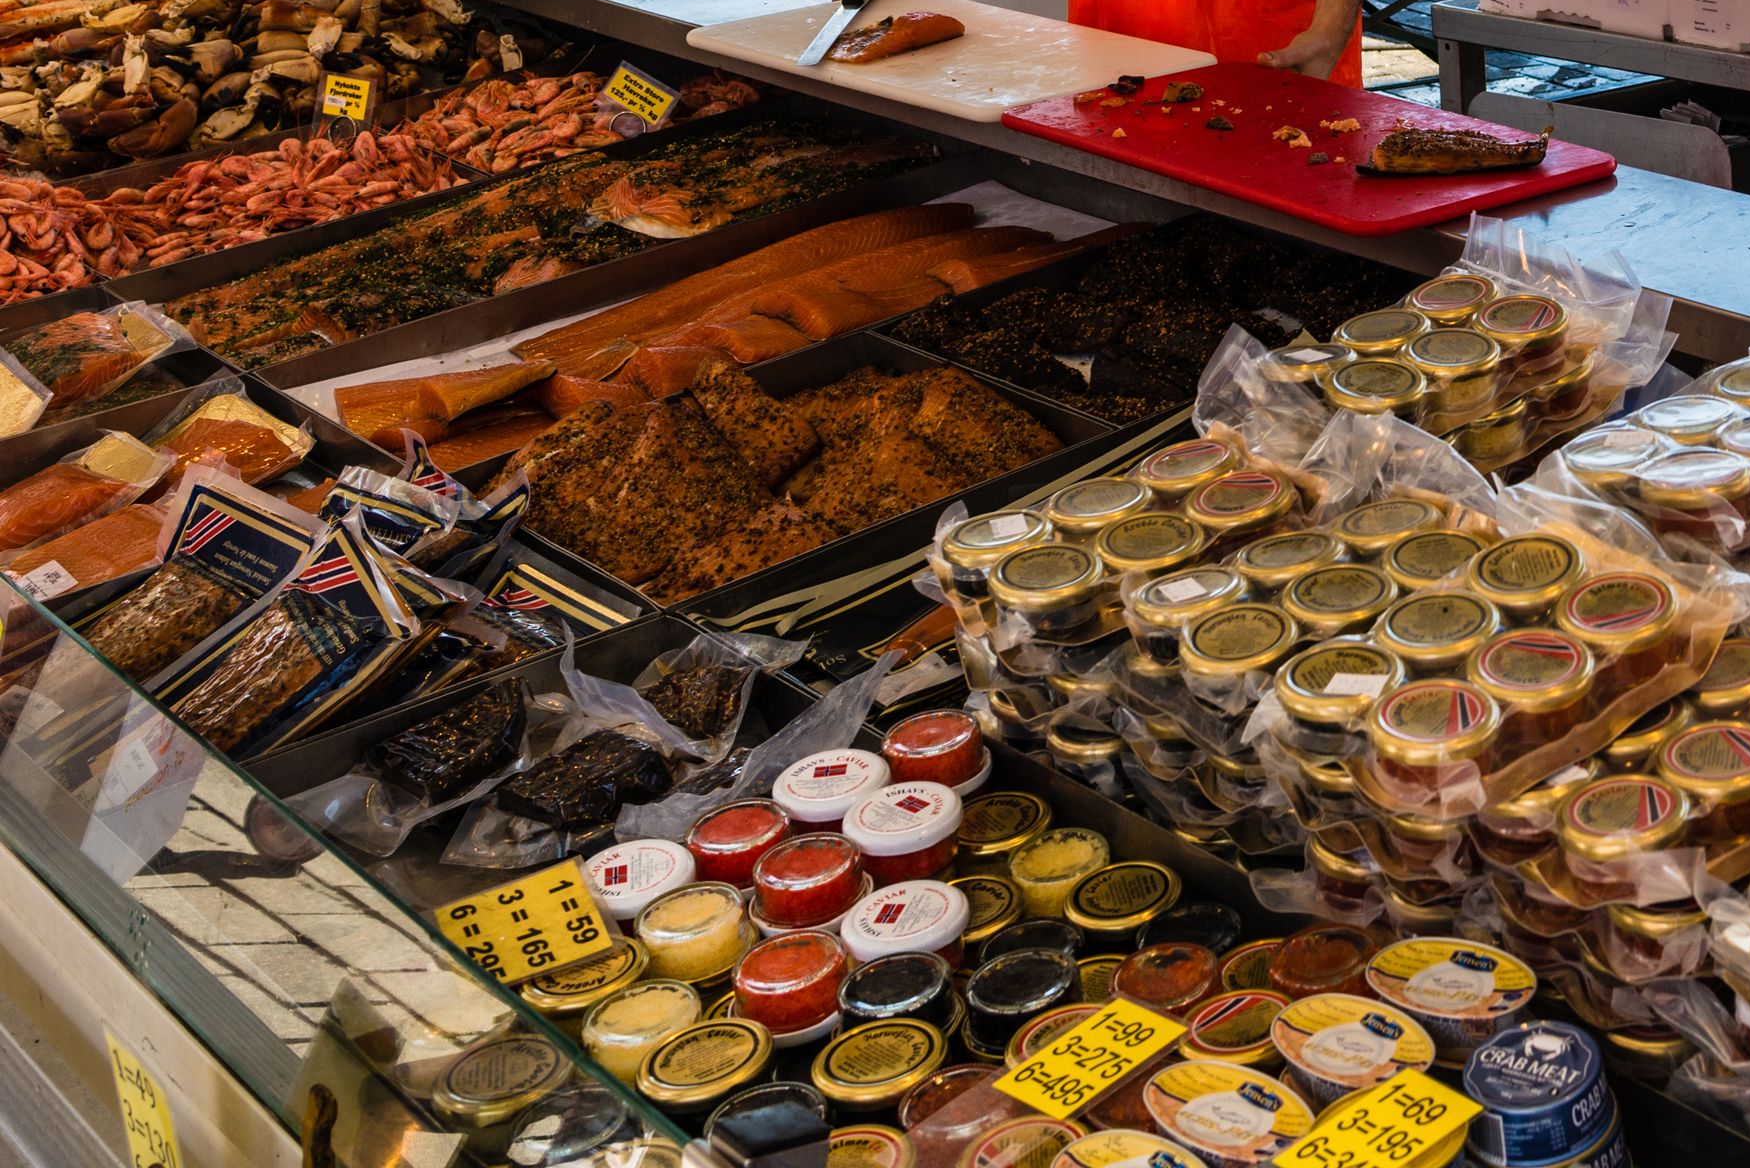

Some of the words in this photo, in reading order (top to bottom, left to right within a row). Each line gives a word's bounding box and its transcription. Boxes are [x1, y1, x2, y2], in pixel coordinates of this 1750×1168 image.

[623, 74, 643, 90] Extra
[644, 86, 664, 103] Store
[623, 84, 656, 107] Havreker
[340, 107, 348, 116] kg
[628, 99, 638, 107] pr
[648, 110, 658, 121] kg
[1123, 519, 1161, 534] Arctic
[1204, 612, 1247, 634] Norwegian
[791, 758, 825, 778] ISHAVS
[836, 755, 869, 770] CAVIAR
[885, 785, 926, 799] ISHAVS
[929, 792, 945, 817] CAVIAR
[867, 888, 908, 911] CAVIAR
[971, 881, 1005, 901] Caviar
[449, 904, 477, 920] 6
[548, 880, 574, 895] 1
[566, 913, 599, 946] 59
[498, 889, 525, 905] 3
[516, 927, 556, 968] 165
[1453, 950, 1496, 972] Jensen's
[560, 974, 606, 991] Arctic
[862, 1028, 916, 1045] Norwegian
[1090, 1011, 1156, 1047] 1=99
[1362, 1014, 1404, 1039] Jensen's
[659, 1036, 700, 1070] Norwegian
[707, 1029, 745, 1042] Caviar
[1053, 1035, 1133, 1079] 3=275
[1480, 1048, 1527, 1071] CRAB
[1528, 1058, 1581, 1084] MEAT
[1013, 1061, 1095, 1107] 6=495
[1238, 1084, 1281, 1111] Jensen's
[1377, 1083, 1448, 1126] 1=69
[1572, 1085, 1601, 1127] CRAB
[1337, 1108, 1425, 1162] 3=195
